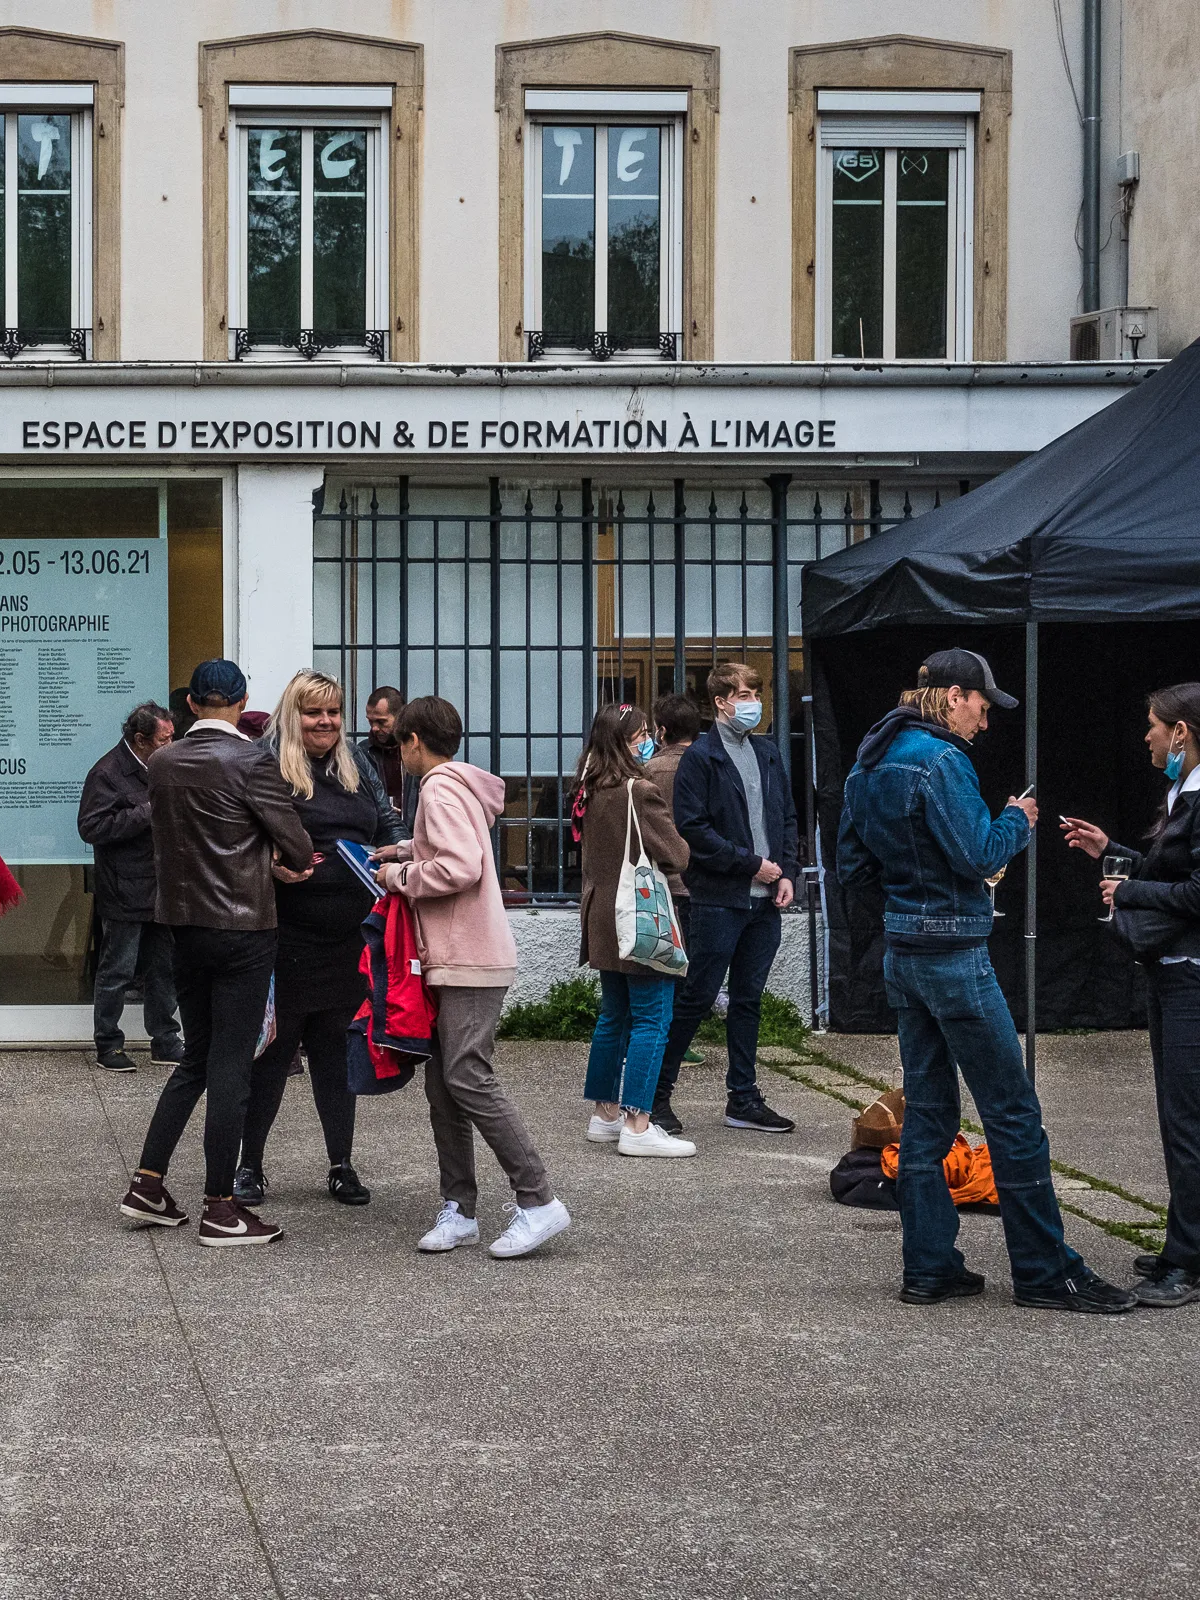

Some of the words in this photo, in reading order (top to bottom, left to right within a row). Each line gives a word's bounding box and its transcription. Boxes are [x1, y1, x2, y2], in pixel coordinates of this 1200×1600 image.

[842, 155, 874, 168] G5
[23, 421, 146, 449] ESPACE
[159, 421, 380, 448] D'EXPOSITION
[394, 421, 415, 447] &
[429, 421, 468, 447] DE
[482, 421, 666, 449] FORMATION
[678, 412, 699, 447] À
[711, 420, 835, 447] L'IMAGE
[60, 549, 150, 575] 13.06.21
[0, 595, 29, 612] ANS
[2, 615, 110, 632] PHOTOGRAPHIE
